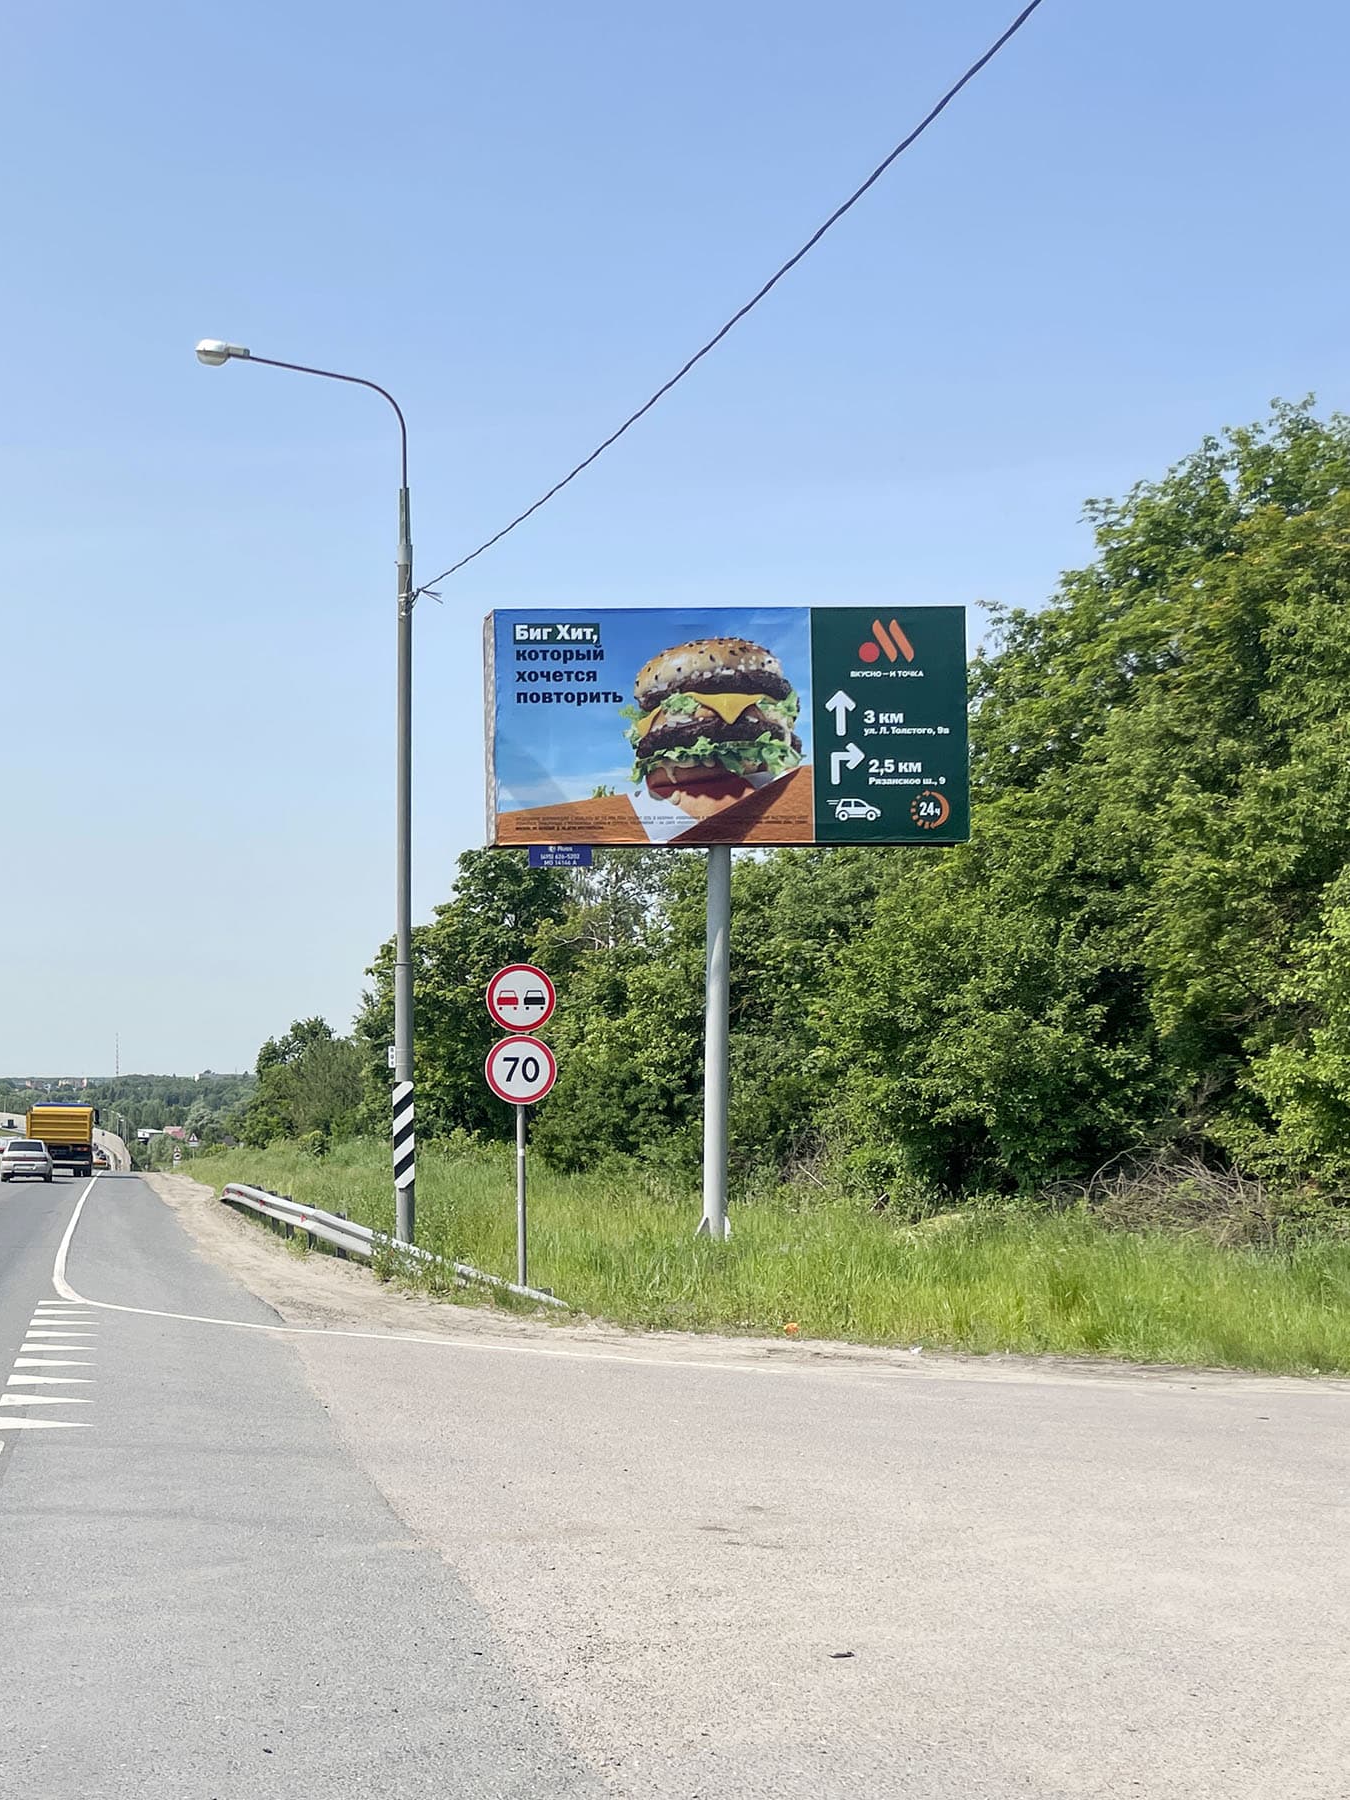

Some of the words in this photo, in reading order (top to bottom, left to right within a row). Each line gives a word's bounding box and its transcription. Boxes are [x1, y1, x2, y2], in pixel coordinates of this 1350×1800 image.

[515, 624, 552, 640] Биг
[556, 624, 598, 643] Хит,
[515, 644, 604, 664] который
[515, 670, 598, 682] хочется
[516, 691, 624, 706] повторить
[863, 710, 875, 724] 3
[879, 713, 904, 723] км
[863, 727, 878, 736] ул.
[879, 726, 890, 734] Л.
[890, 726, 936, 736] Толстого,
[868, 758, 895, 776] 2,5
[898, 762, 922, 773] км
[868, 777, 921, 785] Рязанское
[938, 776, 946, 785] 9
[502, 1056, 540, 1083] 70
